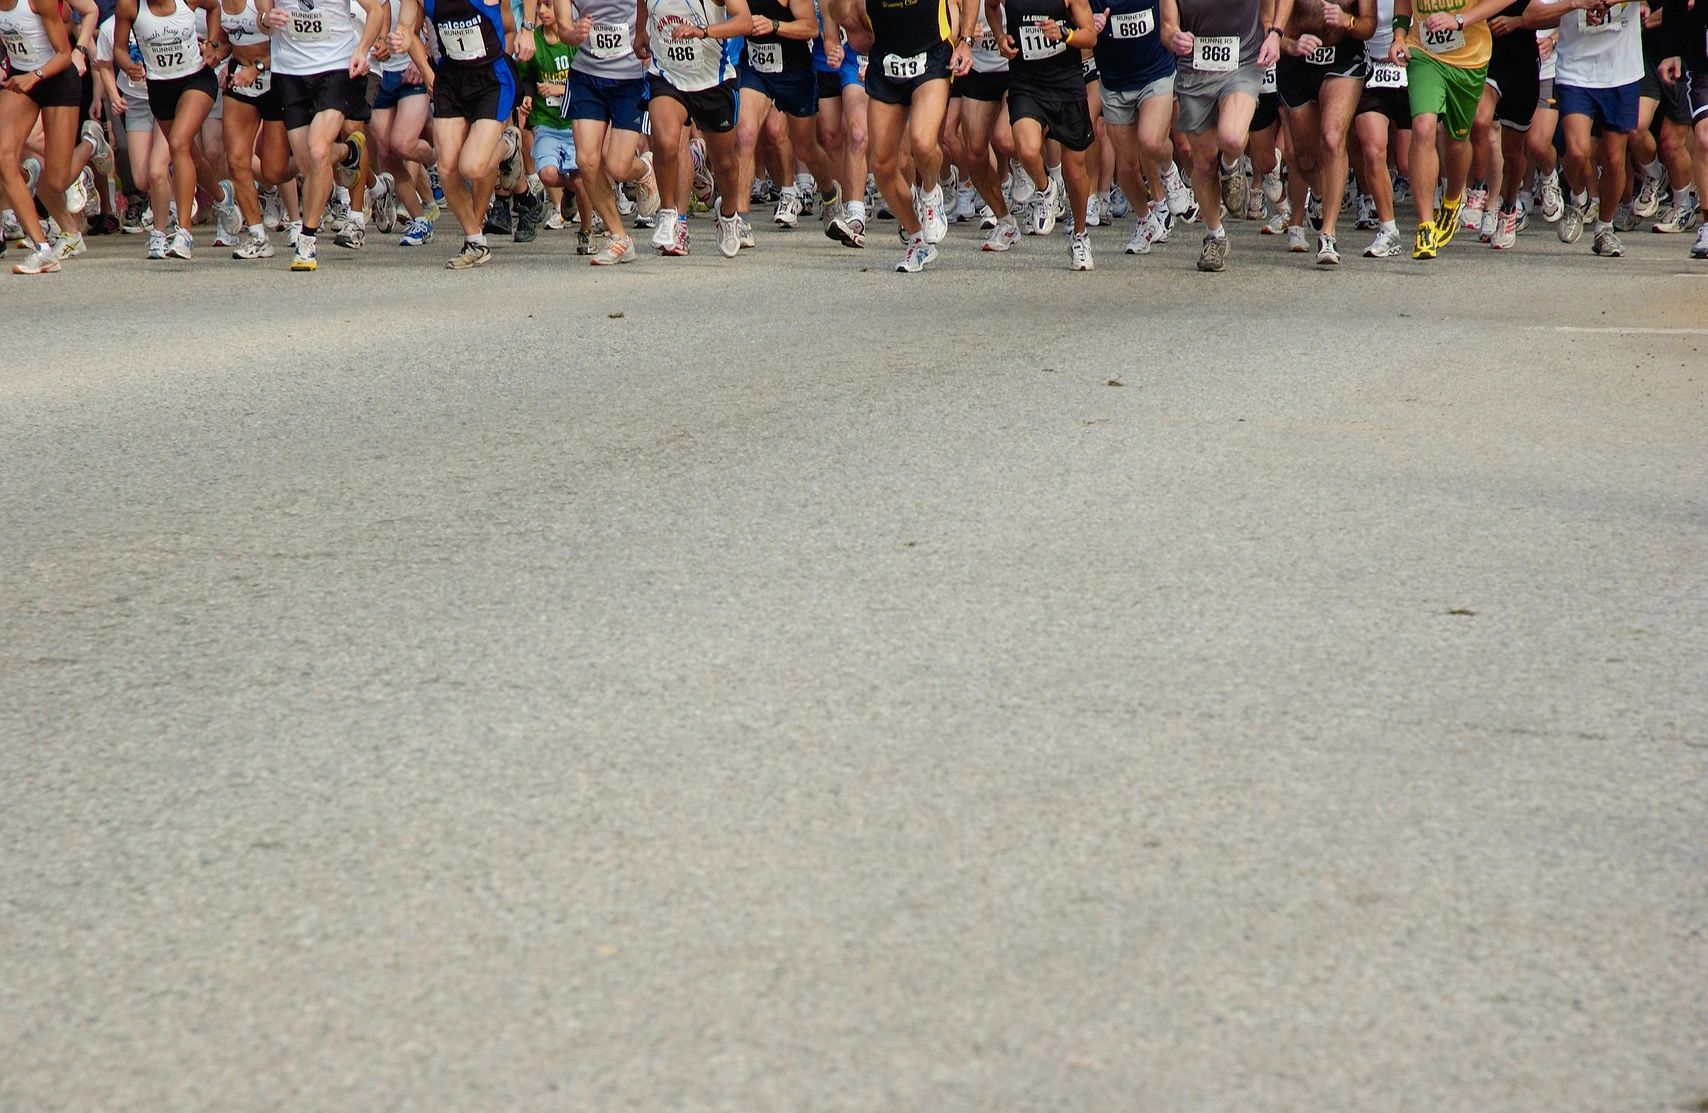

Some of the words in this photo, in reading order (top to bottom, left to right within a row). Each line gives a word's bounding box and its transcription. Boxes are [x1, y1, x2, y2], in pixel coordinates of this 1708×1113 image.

[294, 20, 322, 33] 528
[1120, 20, 1147, 36] 680
[457, 38, 465, 51] 1
[596, 34, 622, 48] 652
[1426, 29, 1455, 45] 262
[156, 52, 185, 67] 872
[667, 46, 695, 61] 486
[752, 49, 775, 64] 264
[1202, 46, 1230, 61] 868
[554, 55, 569, 70] 10
[890, 61, 917, 76] 519
[1375, 69, 1400, 82] 863
